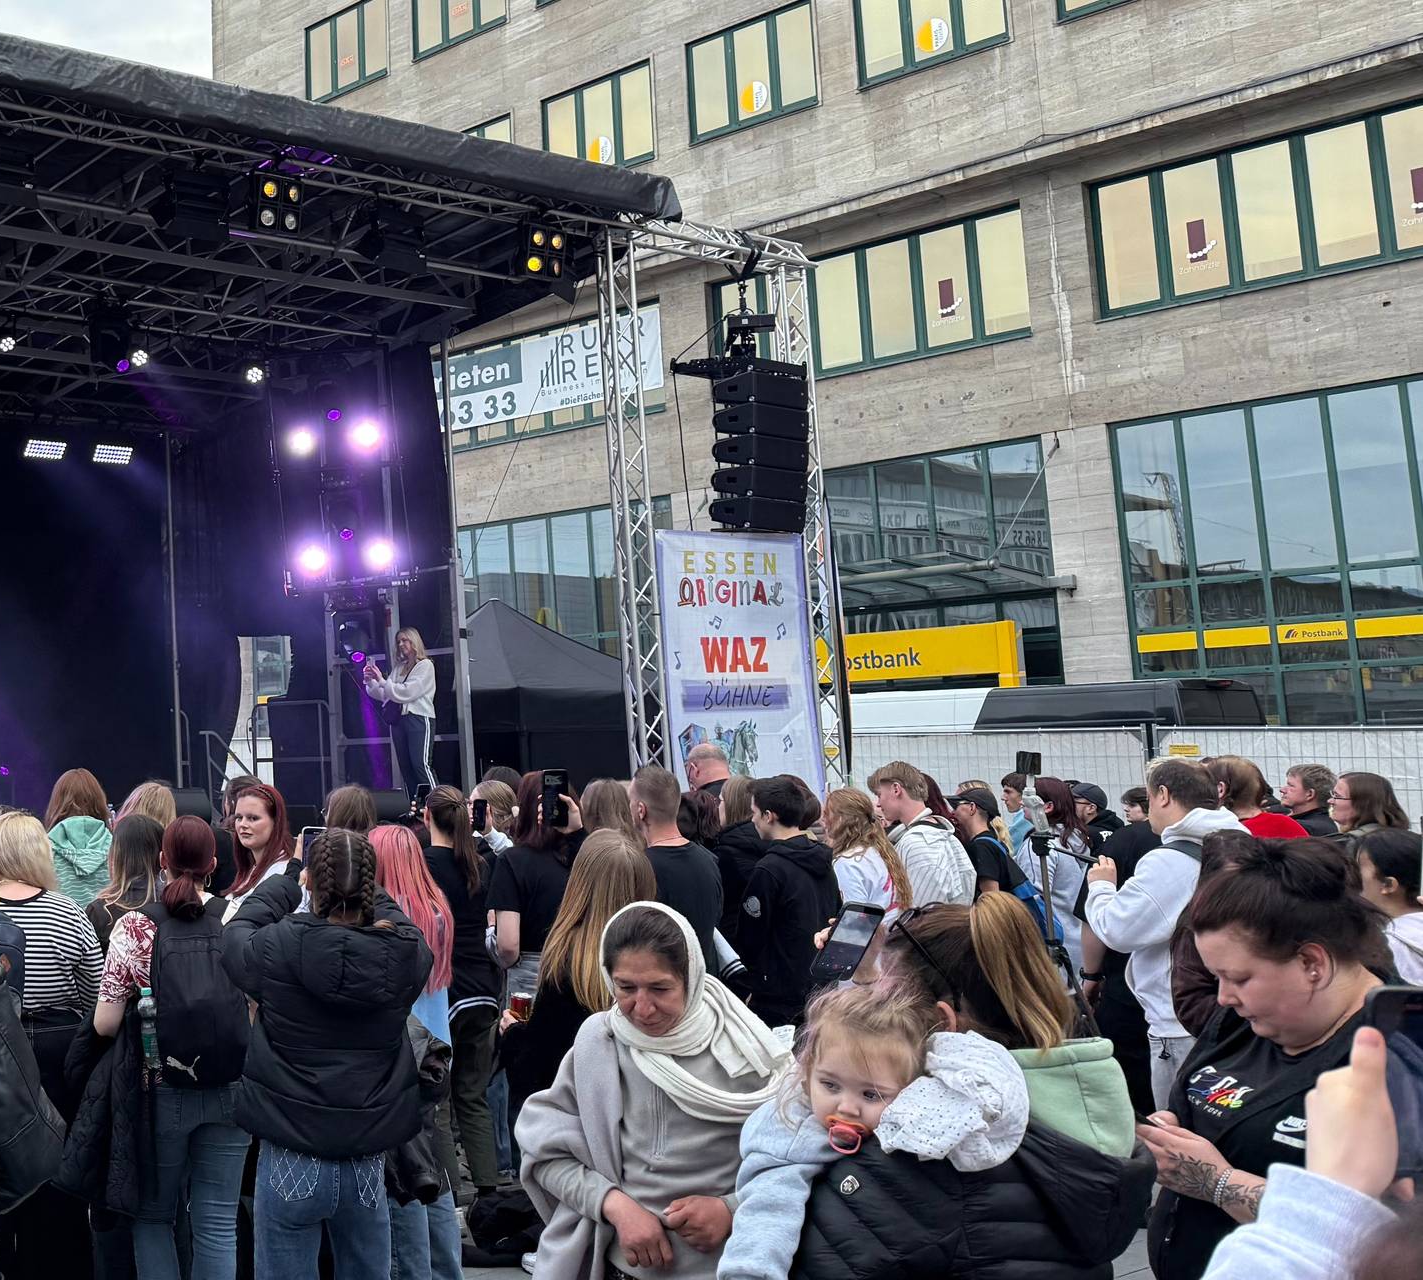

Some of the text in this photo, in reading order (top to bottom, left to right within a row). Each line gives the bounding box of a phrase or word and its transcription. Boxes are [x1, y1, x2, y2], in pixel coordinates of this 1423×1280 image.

[560, 315, 645, 357] RUR
[483, 390, 517, 420] 33
[683, 551, 777, 575] ESSEN
[1302, 628, 1343, 638] Postbank
[699, 636, 769, 674] WAZ
[846, 646, 921, 671] ostbank
[703, 677, 774, 711] BÜHNE
